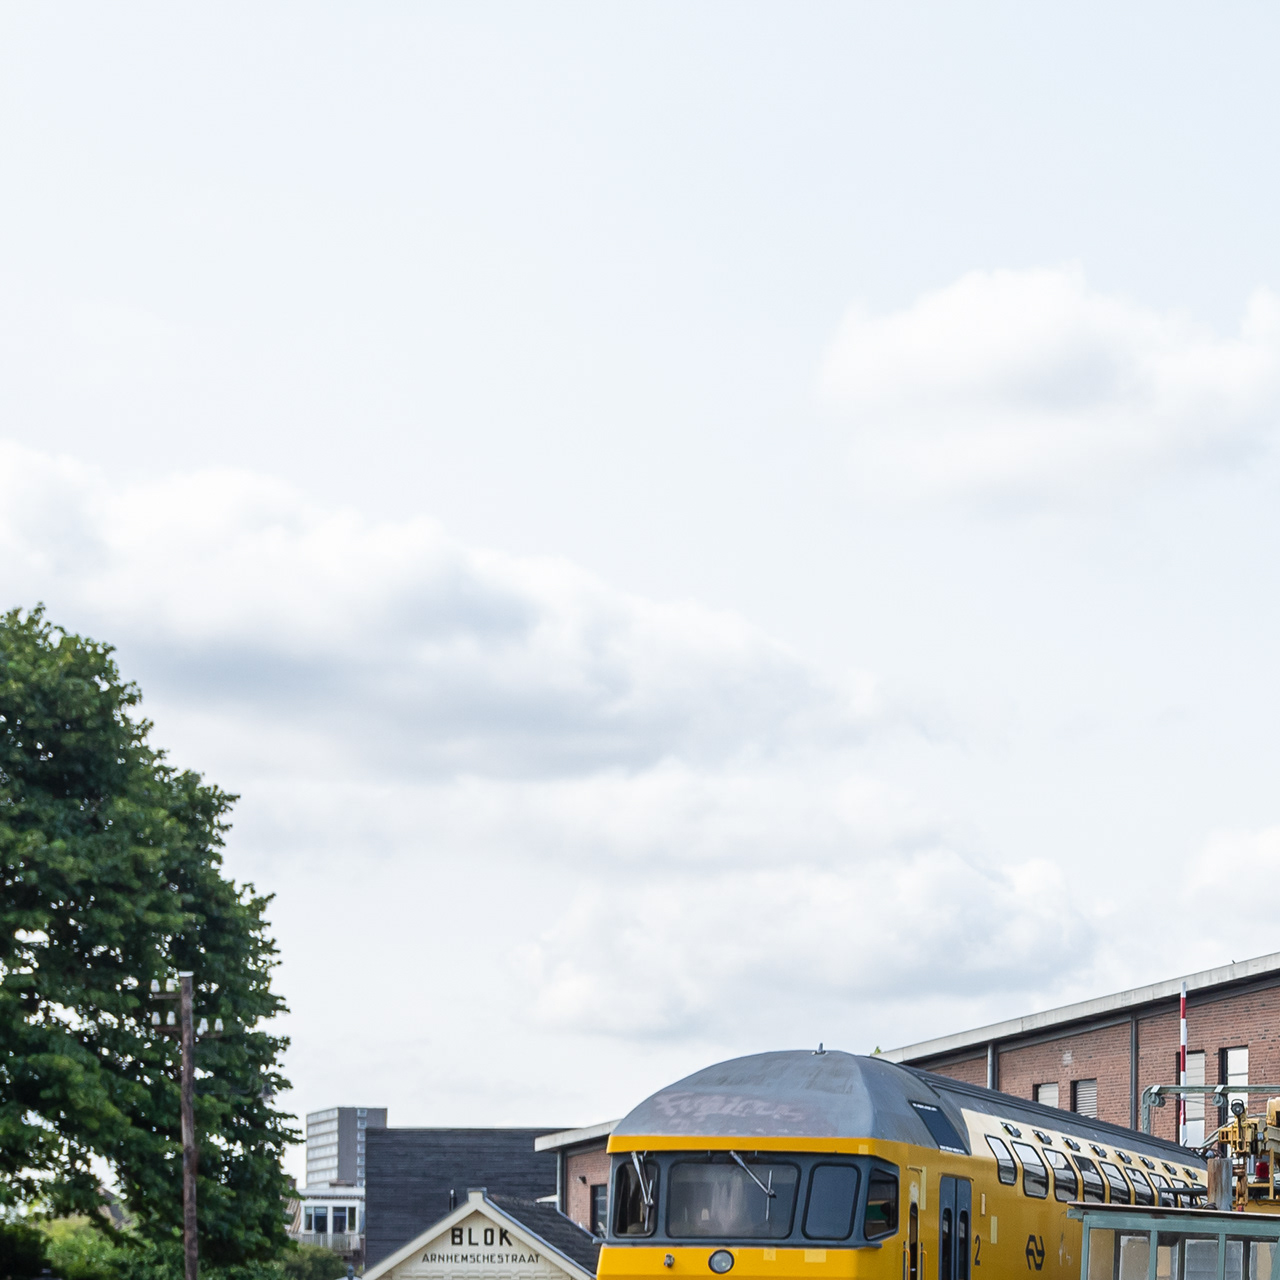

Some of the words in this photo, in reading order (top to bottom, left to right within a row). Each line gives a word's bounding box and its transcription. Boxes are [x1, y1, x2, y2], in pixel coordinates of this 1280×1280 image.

[451, 1227, 513, 1246] BLOK
[422, 1253, 541, 1264] ARNHEMSCHESTRAAT
[974, 1235, 981, 1266] 2
